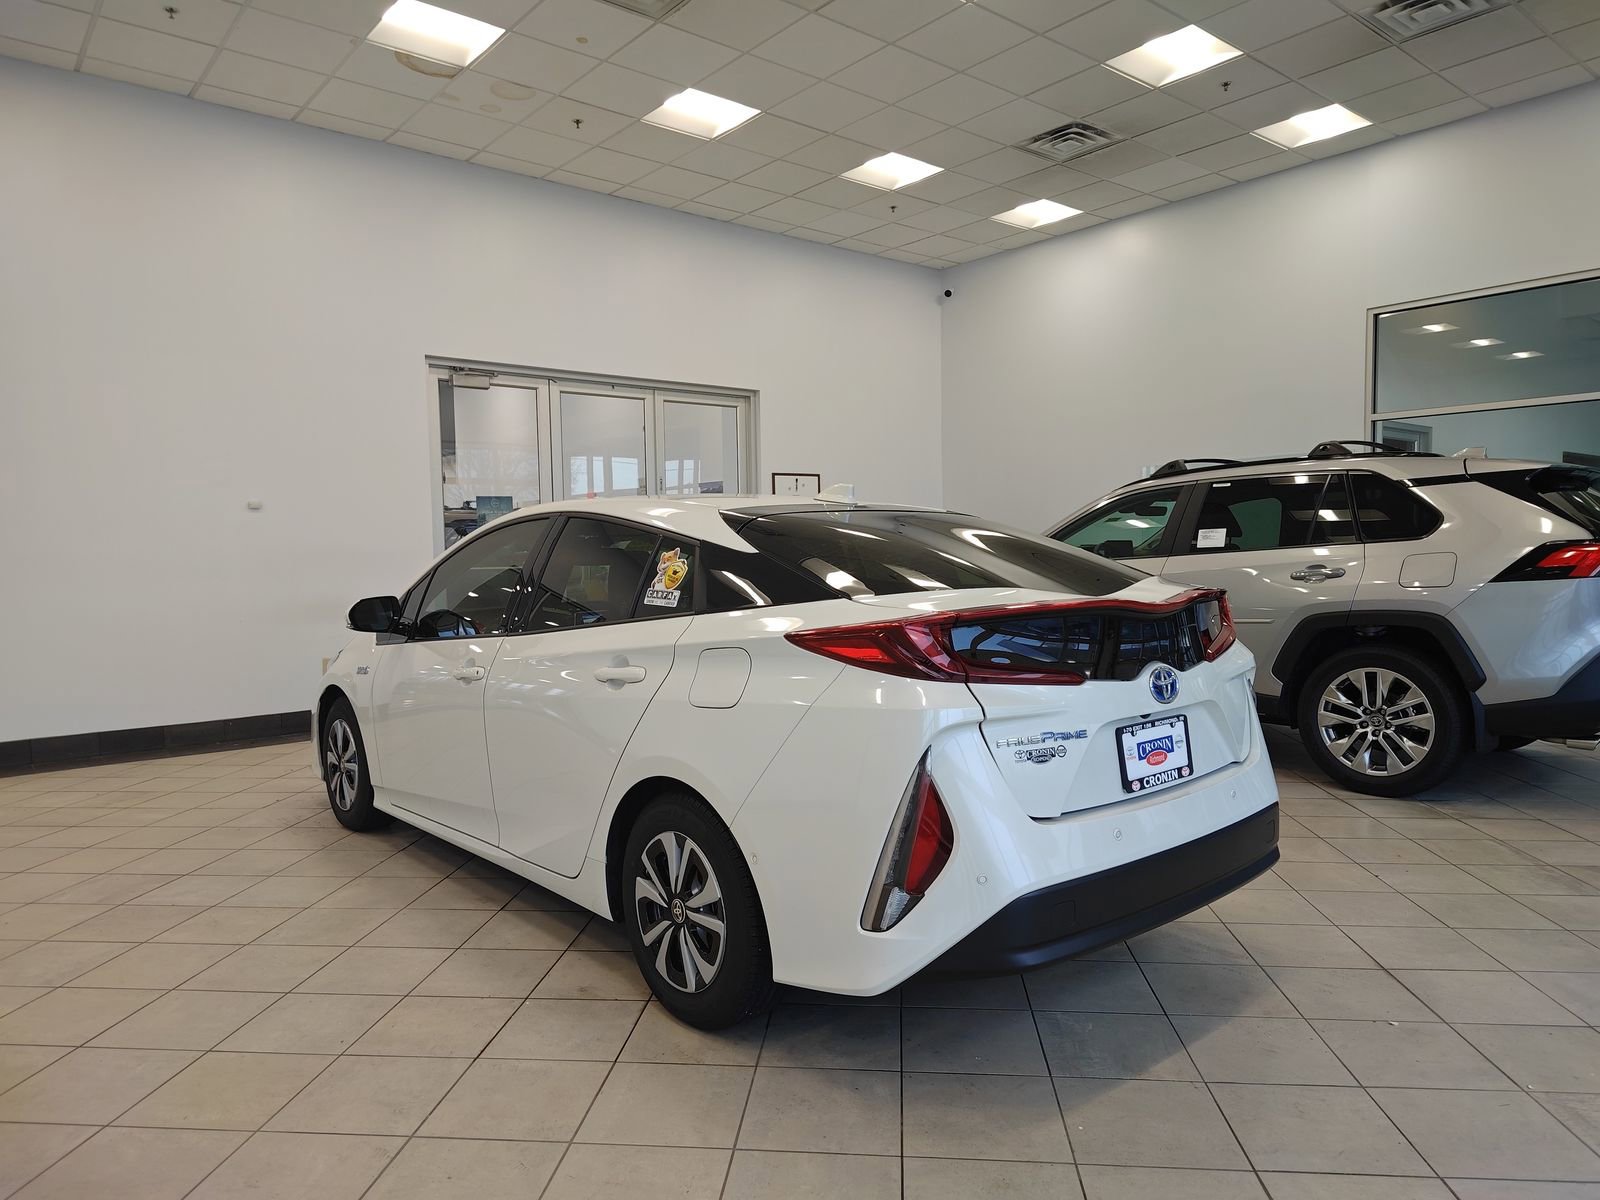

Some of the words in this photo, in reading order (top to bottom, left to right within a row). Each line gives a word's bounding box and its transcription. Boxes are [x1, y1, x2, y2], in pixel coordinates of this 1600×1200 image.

[1040, 729, 1088, 744] PRIME
[1026, 747, 1056, 759] CRONIN
[1140, 737, 1172, 758] CRONIN
[1143, 769, 1179, 788] CRONIN
